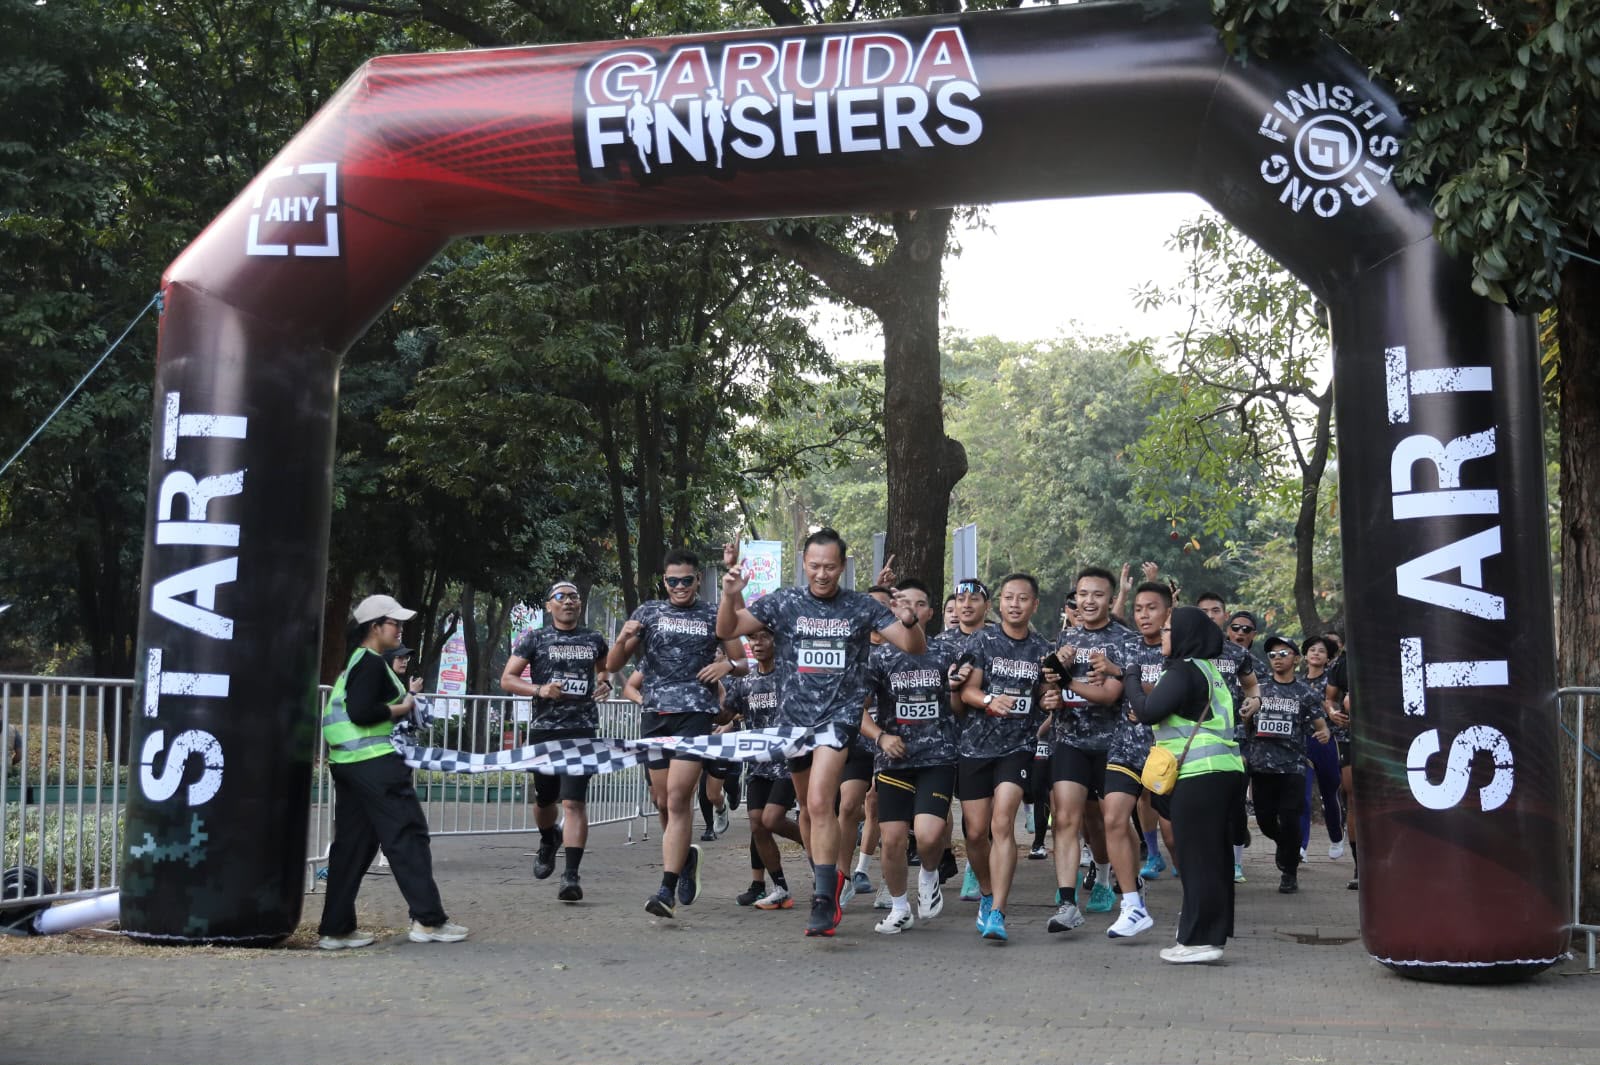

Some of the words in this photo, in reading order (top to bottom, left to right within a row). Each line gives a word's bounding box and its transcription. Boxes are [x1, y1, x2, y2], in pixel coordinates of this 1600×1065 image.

[585, 27, 979, 108] GARUDA
[1258, 82, 1387, 143] FINISH
[586, 80, 983, 174] FINISHERS
[1260, 135, 1399, 218] STRONG
[265, 196, 320, 222] AHY
[1384, 345, 1515, 813] START
[140, 391, 248, 807] START
[658, 616, 708, 628] GARUDA
[796, 616, 850, 628] GARUDA
[657, 623, 708, 636] FINISHERS
[796, 625, 851, 637] FINISHERS
[549, 651, 594, 660] FINISHERS
[804, 651, 840, 666] 0001
[993, 656, 1039, 672] GARUDA
[890, 669, 941, 681] GARUDA
[991, 664, 1039, 680] FINISHERS
[555, 681, 586, 693] 044
[891, 677, 941, 691] FINISHERS
[899, 704, 936, 718] 0525
[1260, 720, 1290, 733] 0086
